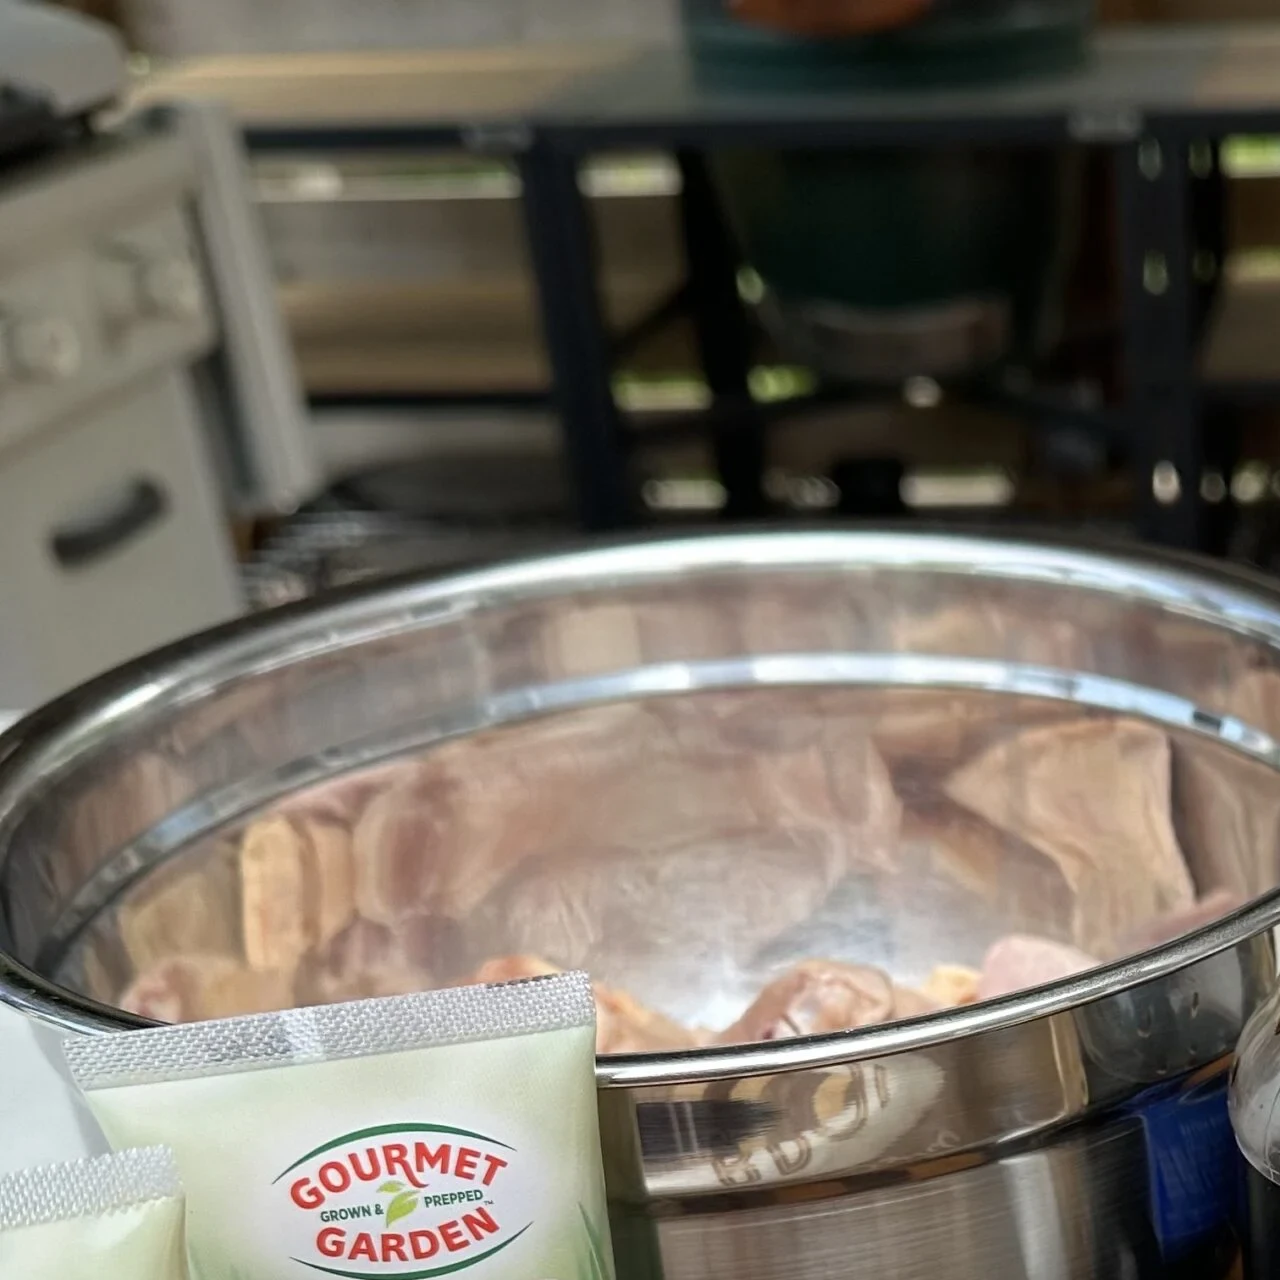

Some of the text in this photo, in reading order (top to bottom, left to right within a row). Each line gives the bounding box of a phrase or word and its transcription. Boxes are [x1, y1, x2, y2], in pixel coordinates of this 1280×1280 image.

[290, 1142, 508, 1210] GOURMET
[320, 1189, 483, 1222] GROWN & PREPPED
[316, 1206, 500, 1262] GARDEN
